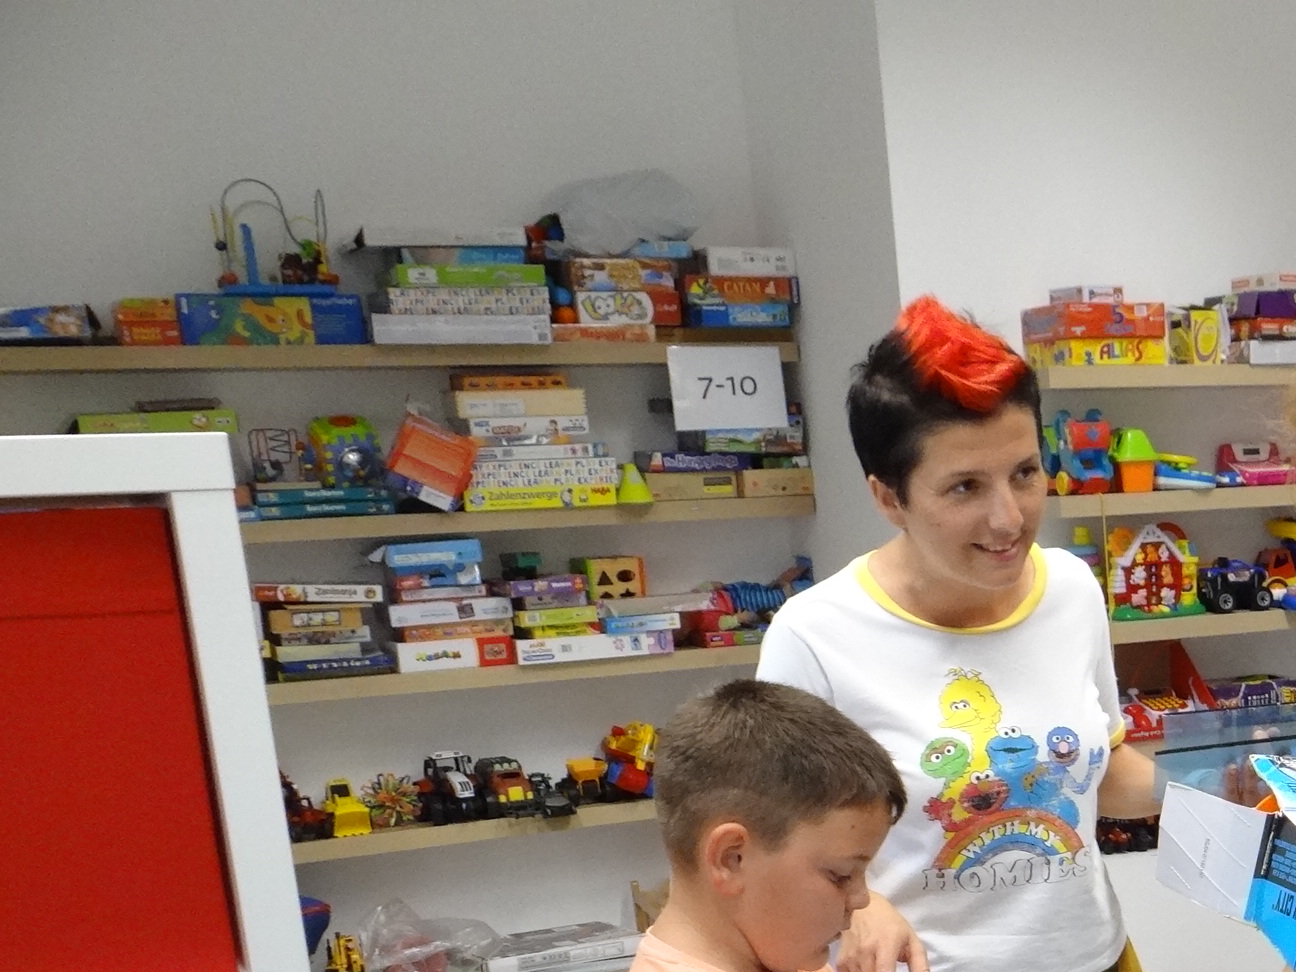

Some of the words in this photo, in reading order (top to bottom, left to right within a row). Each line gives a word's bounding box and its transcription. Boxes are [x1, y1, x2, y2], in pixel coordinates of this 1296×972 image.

[723, 280, 762, 293] CATAN
[1100, 338, 1144, 362] ALIAS
[697, 375, 758, 400] 7-10
[487, 489, 559, 502] Zahlenzwerge
[590, 486, 611, 496] HABA
[960, 820, 1021, 860] WITH
[1025, 822, 1062, 848] MY
[921, 846, 1094, 894] HOMIES
[1274, 889, 1294, 917] CITY
